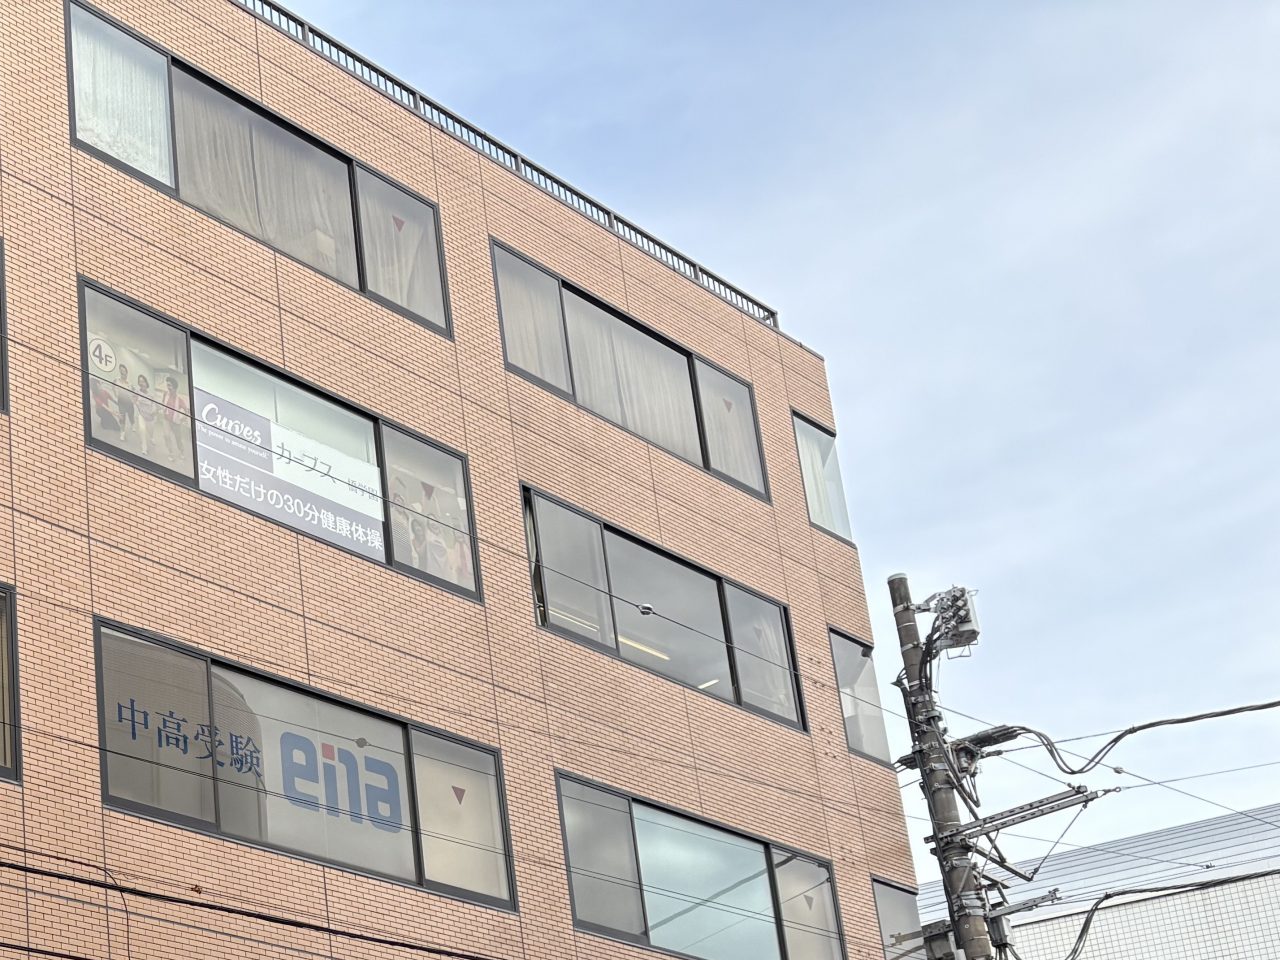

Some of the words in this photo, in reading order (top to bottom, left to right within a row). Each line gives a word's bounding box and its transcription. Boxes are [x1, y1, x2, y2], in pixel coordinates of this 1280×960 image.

[92, 343, 113, 367] 4F
[201, 402, 262, 445] Curves
[276, 442, 337, 485] カーブス
[199, 460, 384, 551] 女性だけの30分健康体操
[116, 698, 264, 779] 中高受験
[280, 730, 403, 834] ena
